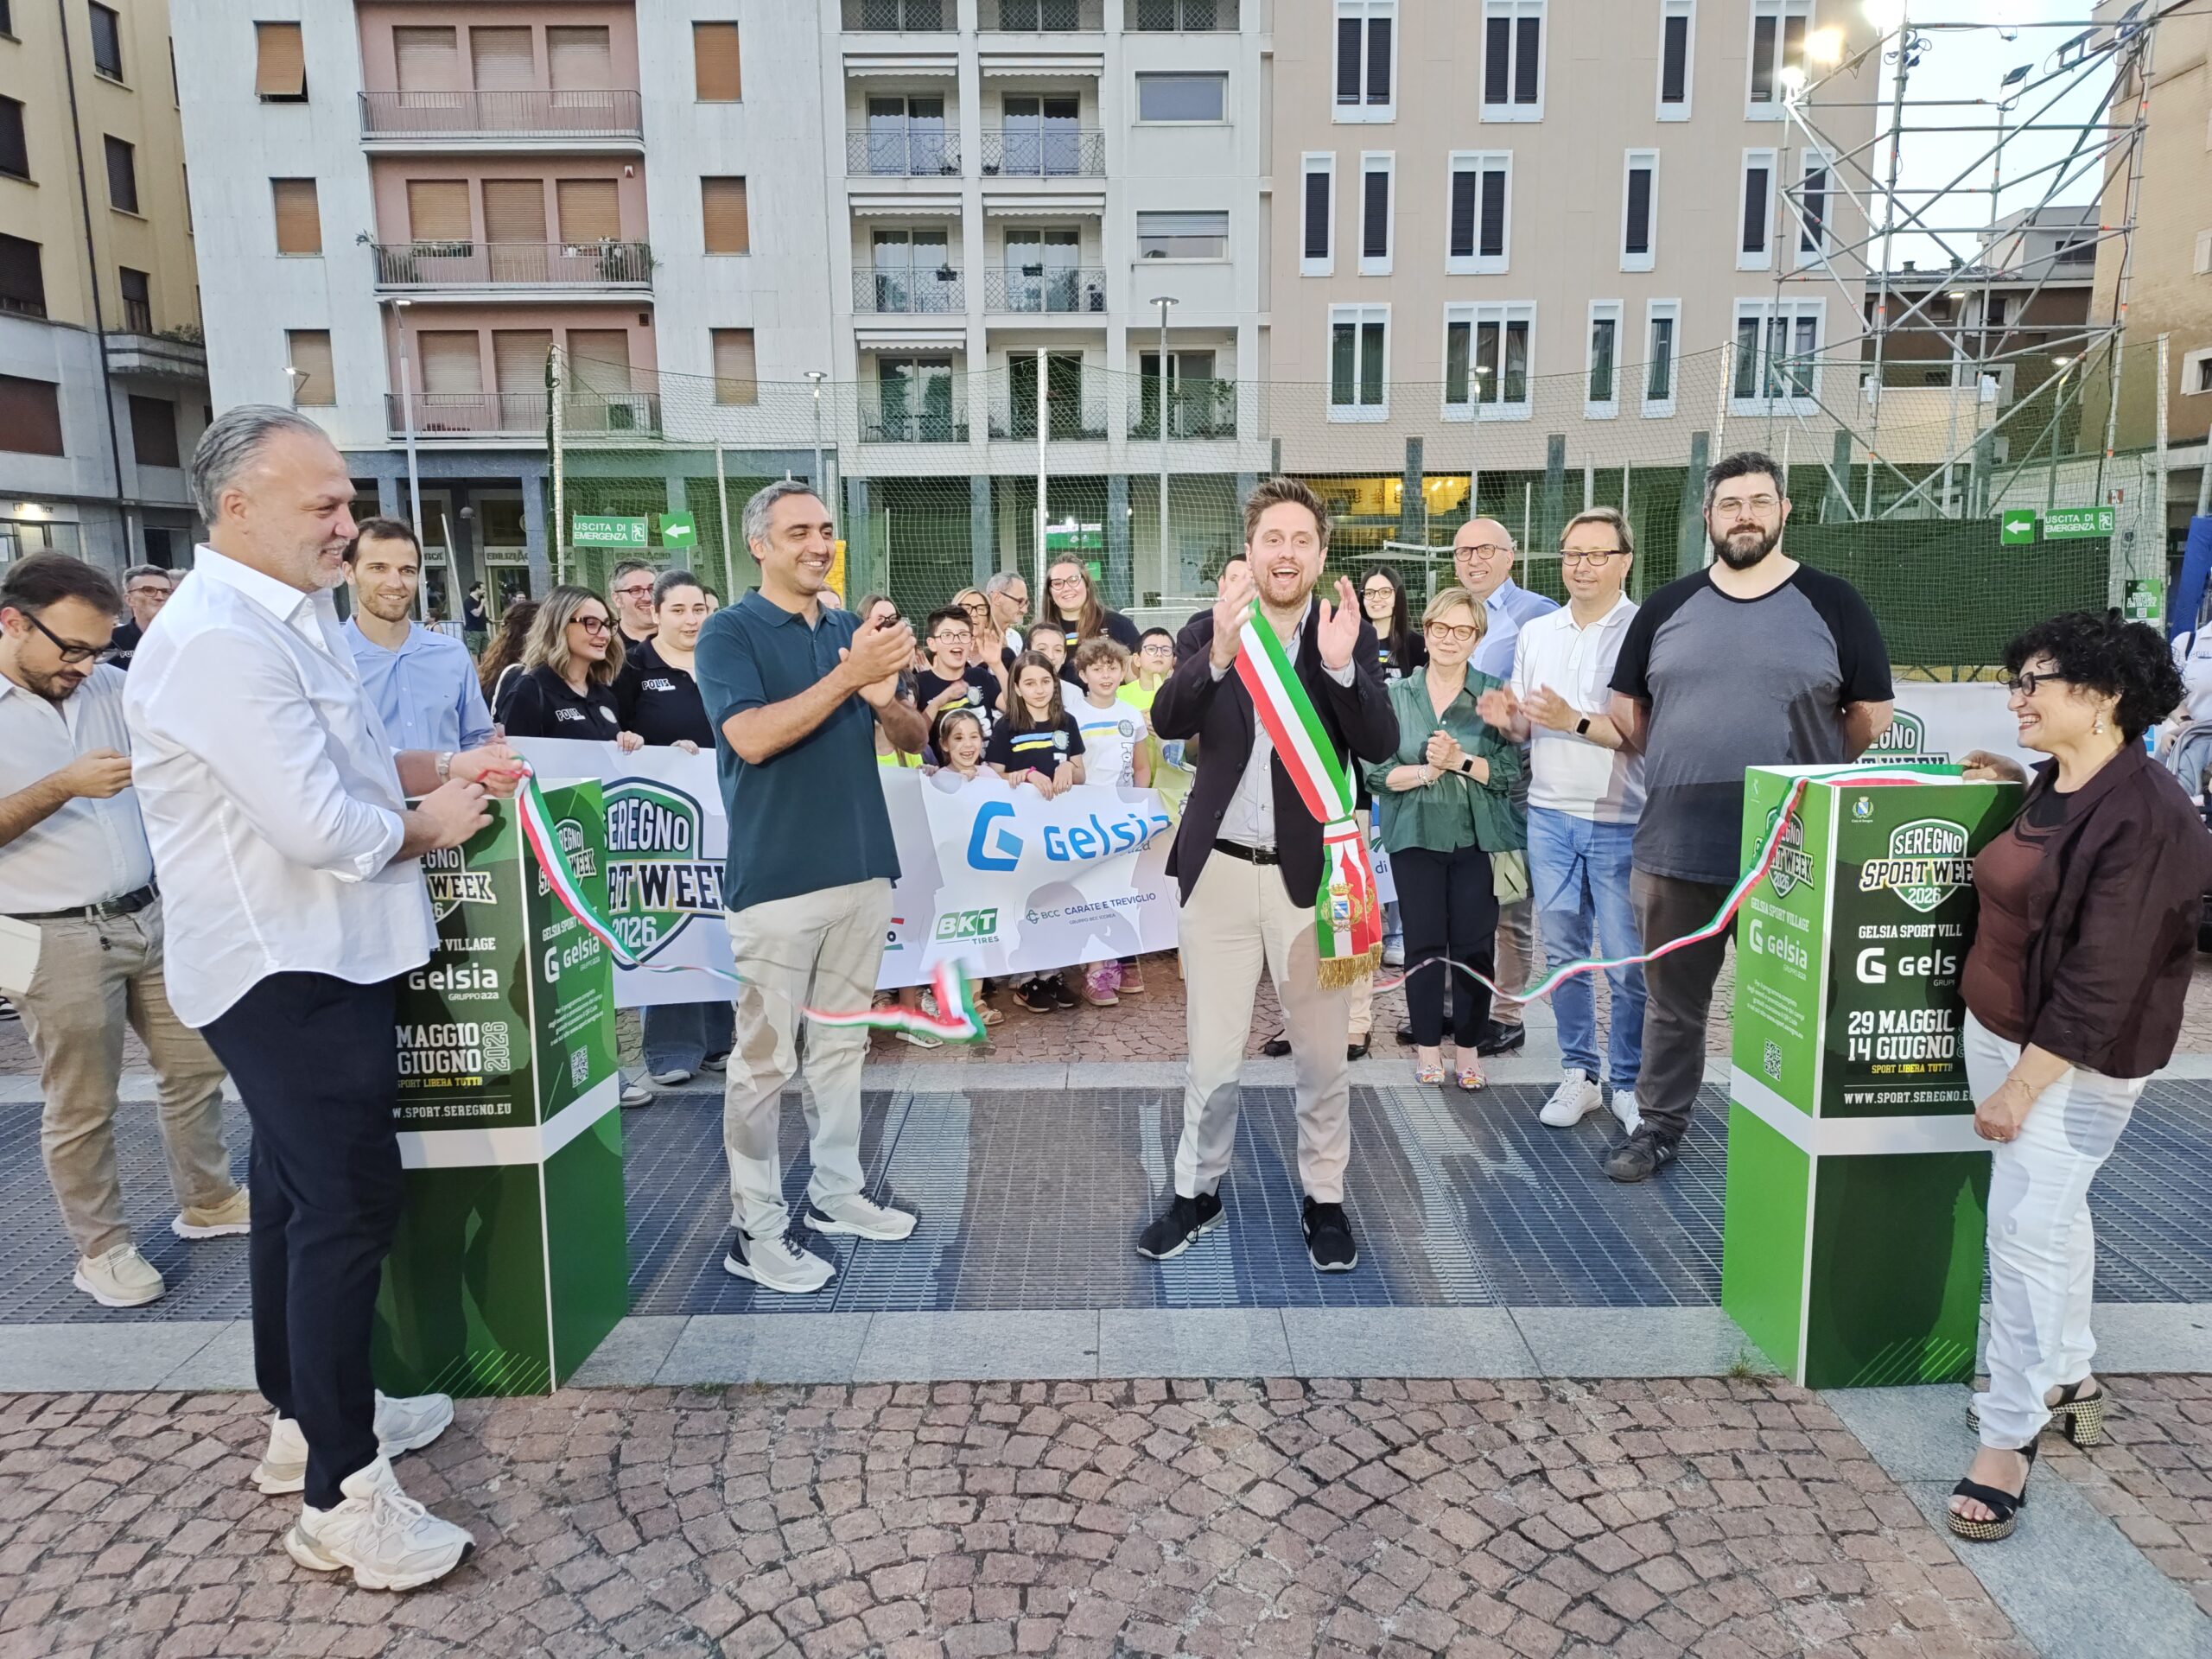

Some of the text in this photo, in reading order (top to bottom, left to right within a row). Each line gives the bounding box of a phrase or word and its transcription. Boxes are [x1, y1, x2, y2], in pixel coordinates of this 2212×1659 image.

[574, 523, 612, 531] USCITA
[2045, 513, 2094, 524] USCITA DI
[2045, 523, 2095, 533] EMERGENZA
[574, 532, 627, 541] EMERGENZA
[605, 798, 690, 851] EREGNO
[556, 827, 582, 852] REGNO
[1894, 827, 1963, 855] SEREGNO
[418, 849, 460, 869] EGNO
[569, 850, 595, 876] WEEK
[1785, 849, 1812, 883] WEEK
[1773, 870, 1789, 889] 2026
[1862, 860, 1974, 888] SPORT WEE
[429, 874, 493, 900] WEEK
[1907, 887, 1942, 904] 2026
[1040, 910, 1060, 919] BCC
[1065, 903, 1102, 915] CARATE
[1109, 893, 1156, 907] TREVIGLIO
[1751, 897, 1809, 932] GELSIA SPORT VILLAGE
[938, 912, 996, 936] BKT
[1859, 924, 1962, 938] GELSIA SPORT VILL
[445, 938, 496, 951] VILLAGE
[563, 932, 600, 968] Gelsia
[971, 936, 1000, 944] TIRES
[1767, 935, 1808, 969] Gelsia
[1898, 949, 1956, 976] Gels
[409, 963, 499, 990] Gelsia
[395, 1022, 480, 1048] MAGGIO
[1848, 1011, 1874, 1035] 29
[481, 1021, 511, 1072] 2026
[1848, 1037, 1872, 1061] 14
[1876, 1035, 1955, 1060] GIUGNO
[397, 1049, 481, 1074] GIUGNO
[1872, 1065, 1896, 1073] SPORT
[1898, 1064, 1925, 1073] LIBERA
[423, 1077, 453, 1087] LIBERA
[392, 1103, 512, 1119] W.SPORT.SEREGNO.EU
